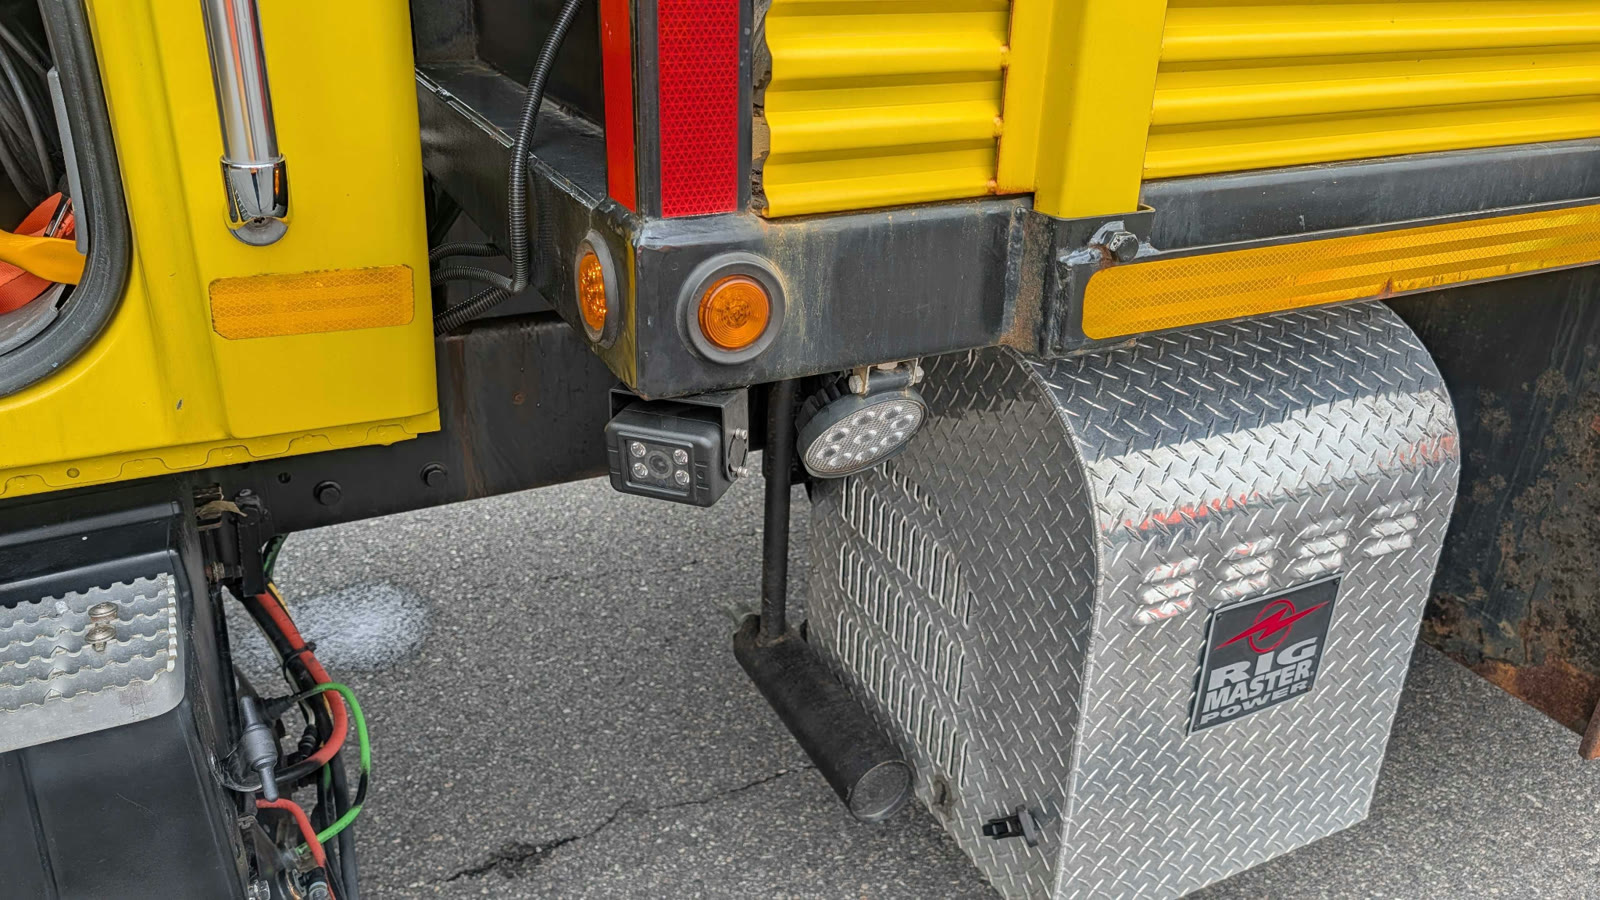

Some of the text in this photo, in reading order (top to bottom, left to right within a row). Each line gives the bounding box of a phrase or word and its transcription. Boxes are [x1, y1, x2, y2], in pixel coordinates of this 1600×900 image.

[1202, 659, 1313, 713] MASTER
[1207, 636, 1318, 692] RIG
[1200, 680, 1308, 725] POWER
